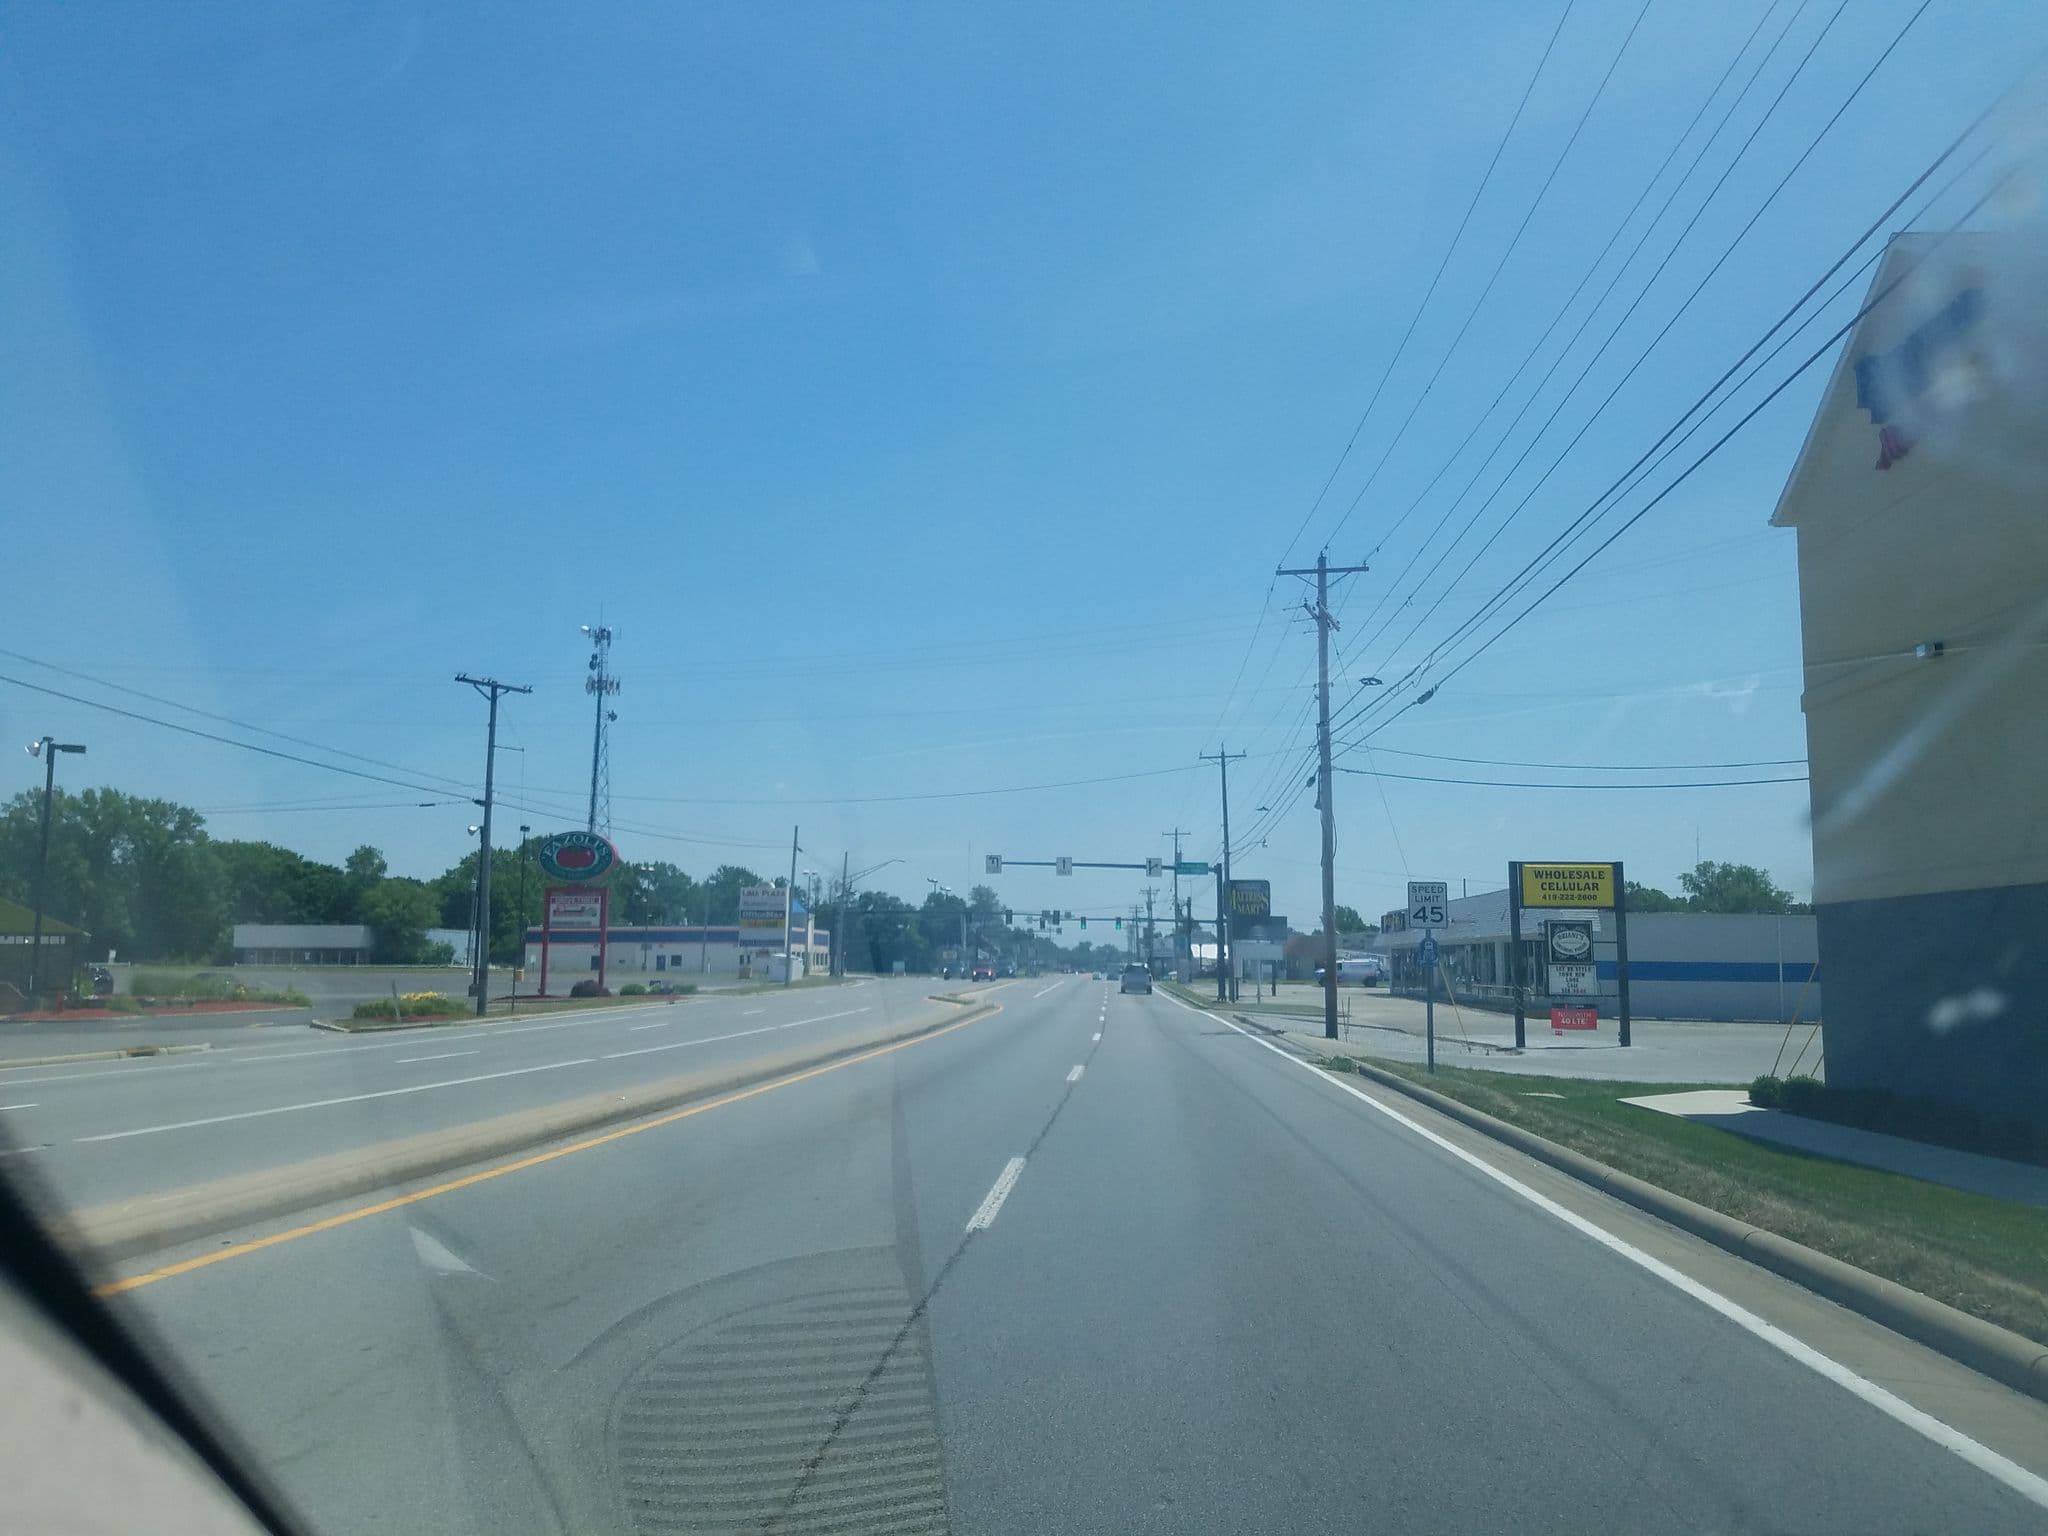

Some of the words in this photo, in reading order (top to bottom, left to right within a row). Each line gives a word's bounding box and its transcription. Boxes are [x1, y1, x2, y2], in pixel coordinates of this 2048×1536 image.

[1534, 870, 1605, 880] WHOLESALE
[1411, 886, 1444, 894] SPEED
[1541, 882, 1600, 892] CELLULAR
[1415, 895, 1440, 903] LIMIT
[1413, 906, 1444, 923] 45
